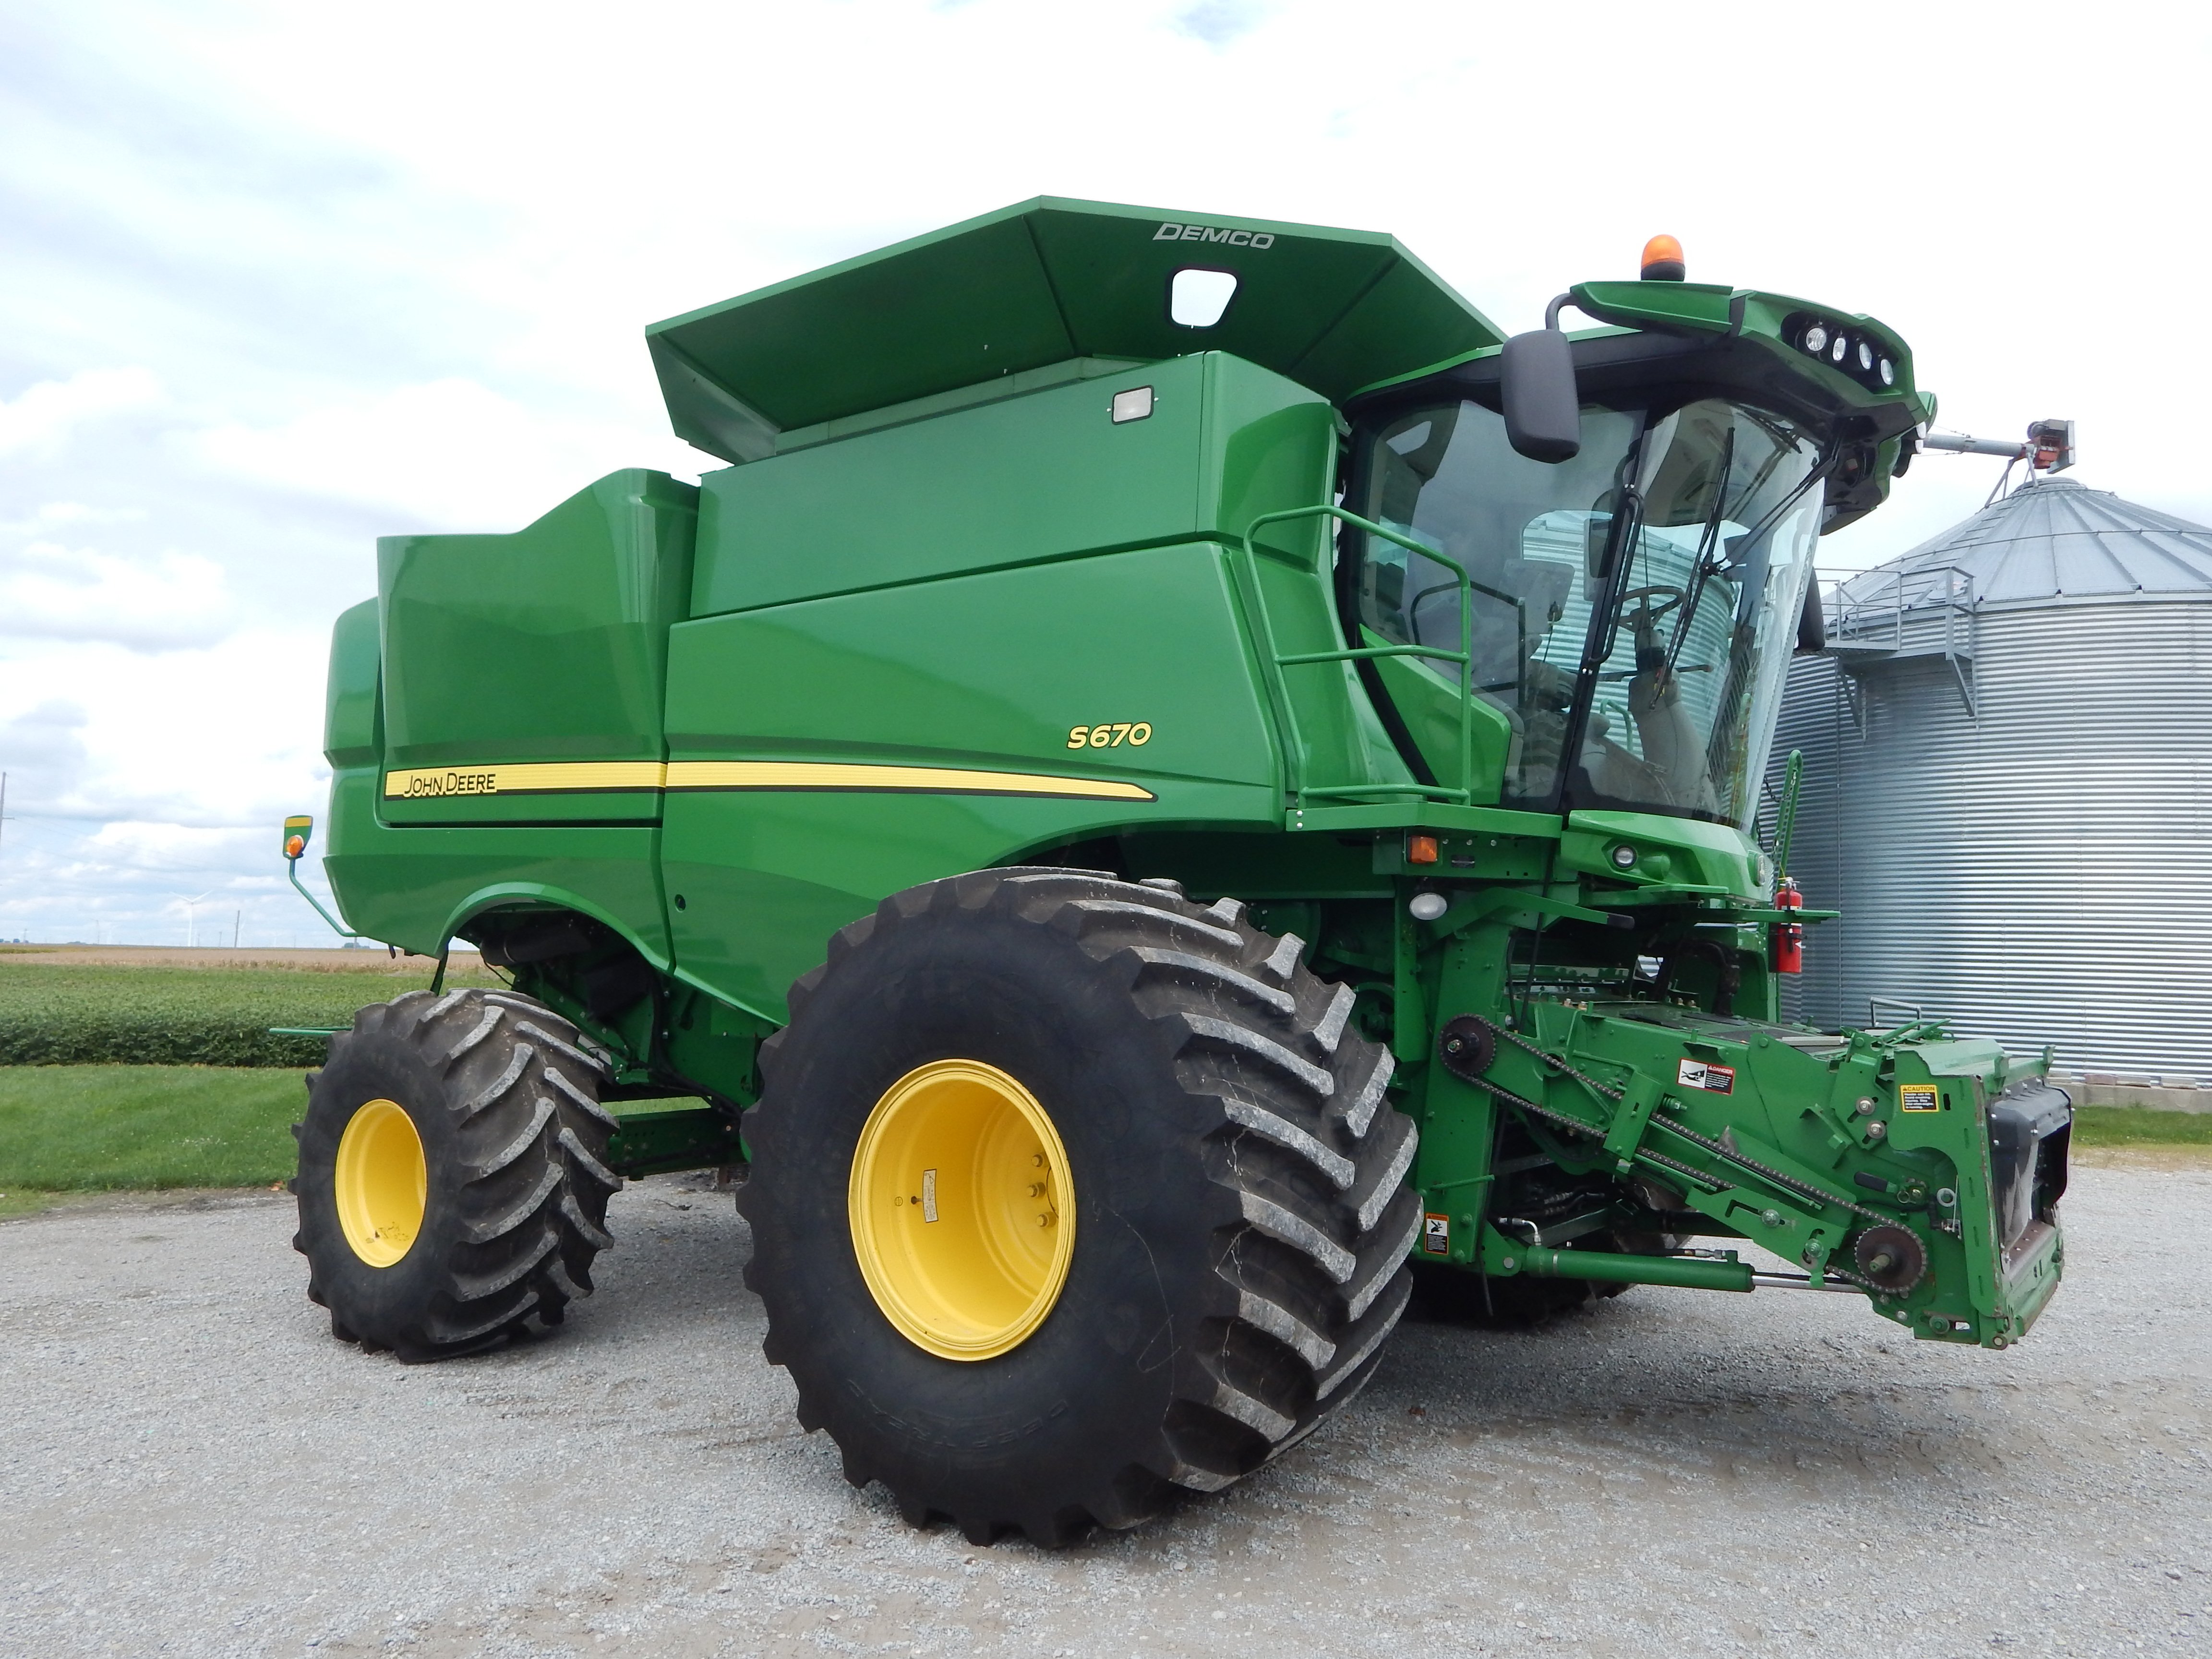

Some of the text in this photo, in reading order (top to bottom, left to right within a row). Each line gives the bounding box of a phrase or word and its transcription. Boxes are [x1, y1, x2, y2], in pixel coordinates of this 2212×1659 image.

[1152, 223, 1275, 250] DEMCO
[1067, 721, 1153, 750] S670
[404, 772, 496, 794] JOHN DEERE
[1712, 1066, 1733, 1075] DANGER
